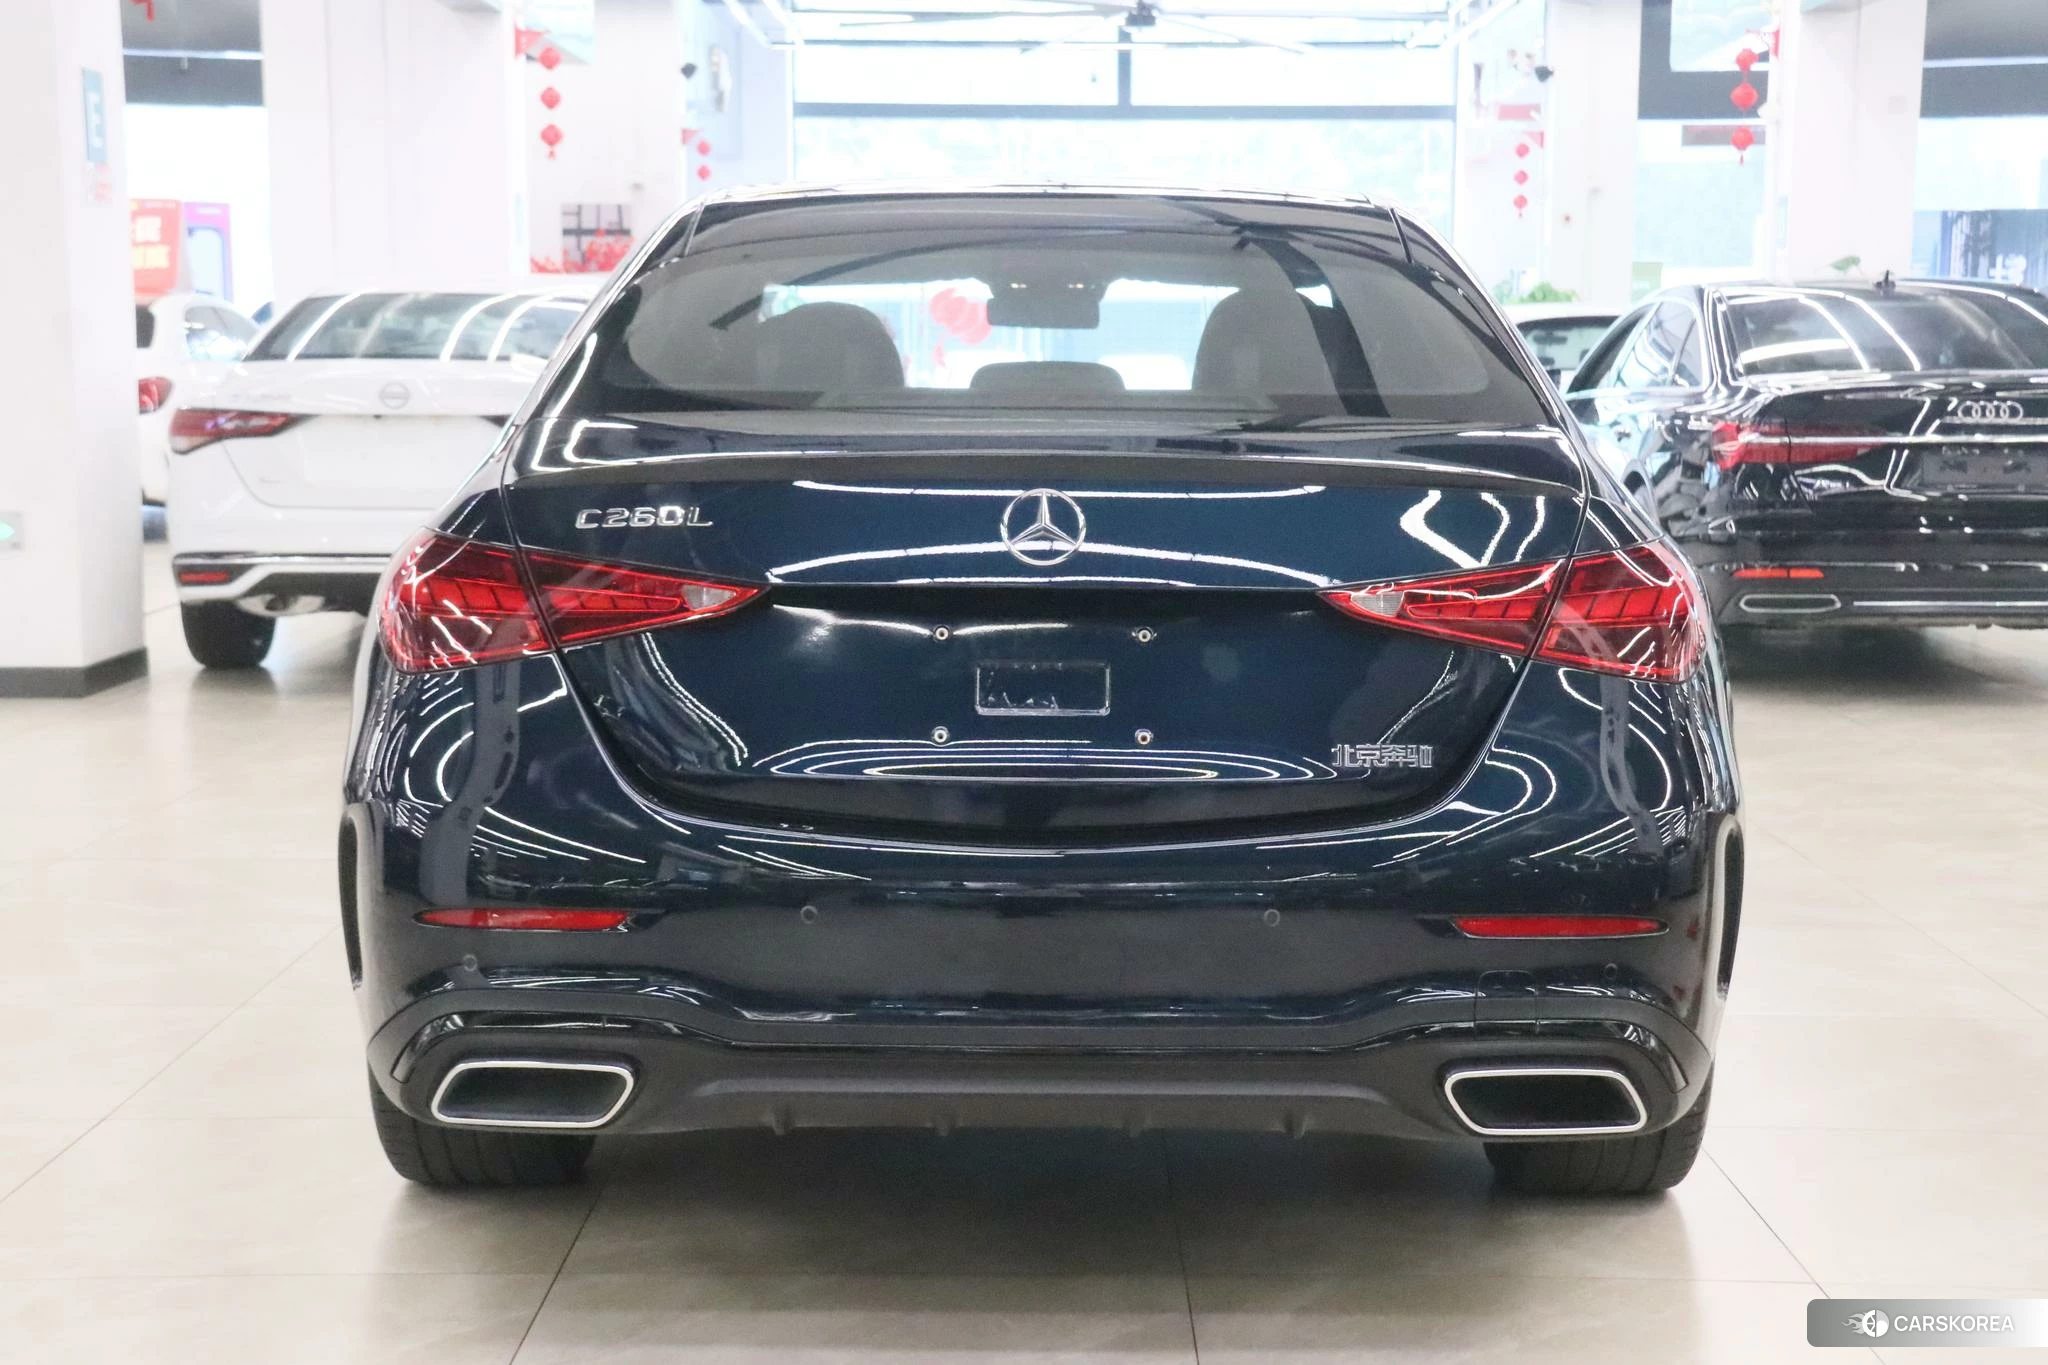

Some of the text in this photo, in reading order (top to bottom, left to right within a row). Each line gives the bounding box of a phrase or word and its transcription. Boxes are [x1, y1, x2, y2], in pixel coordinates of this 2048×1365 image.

[575, 505, 714, 529] C260L
[1331, 743, 1433, 768] 北京奔驰
